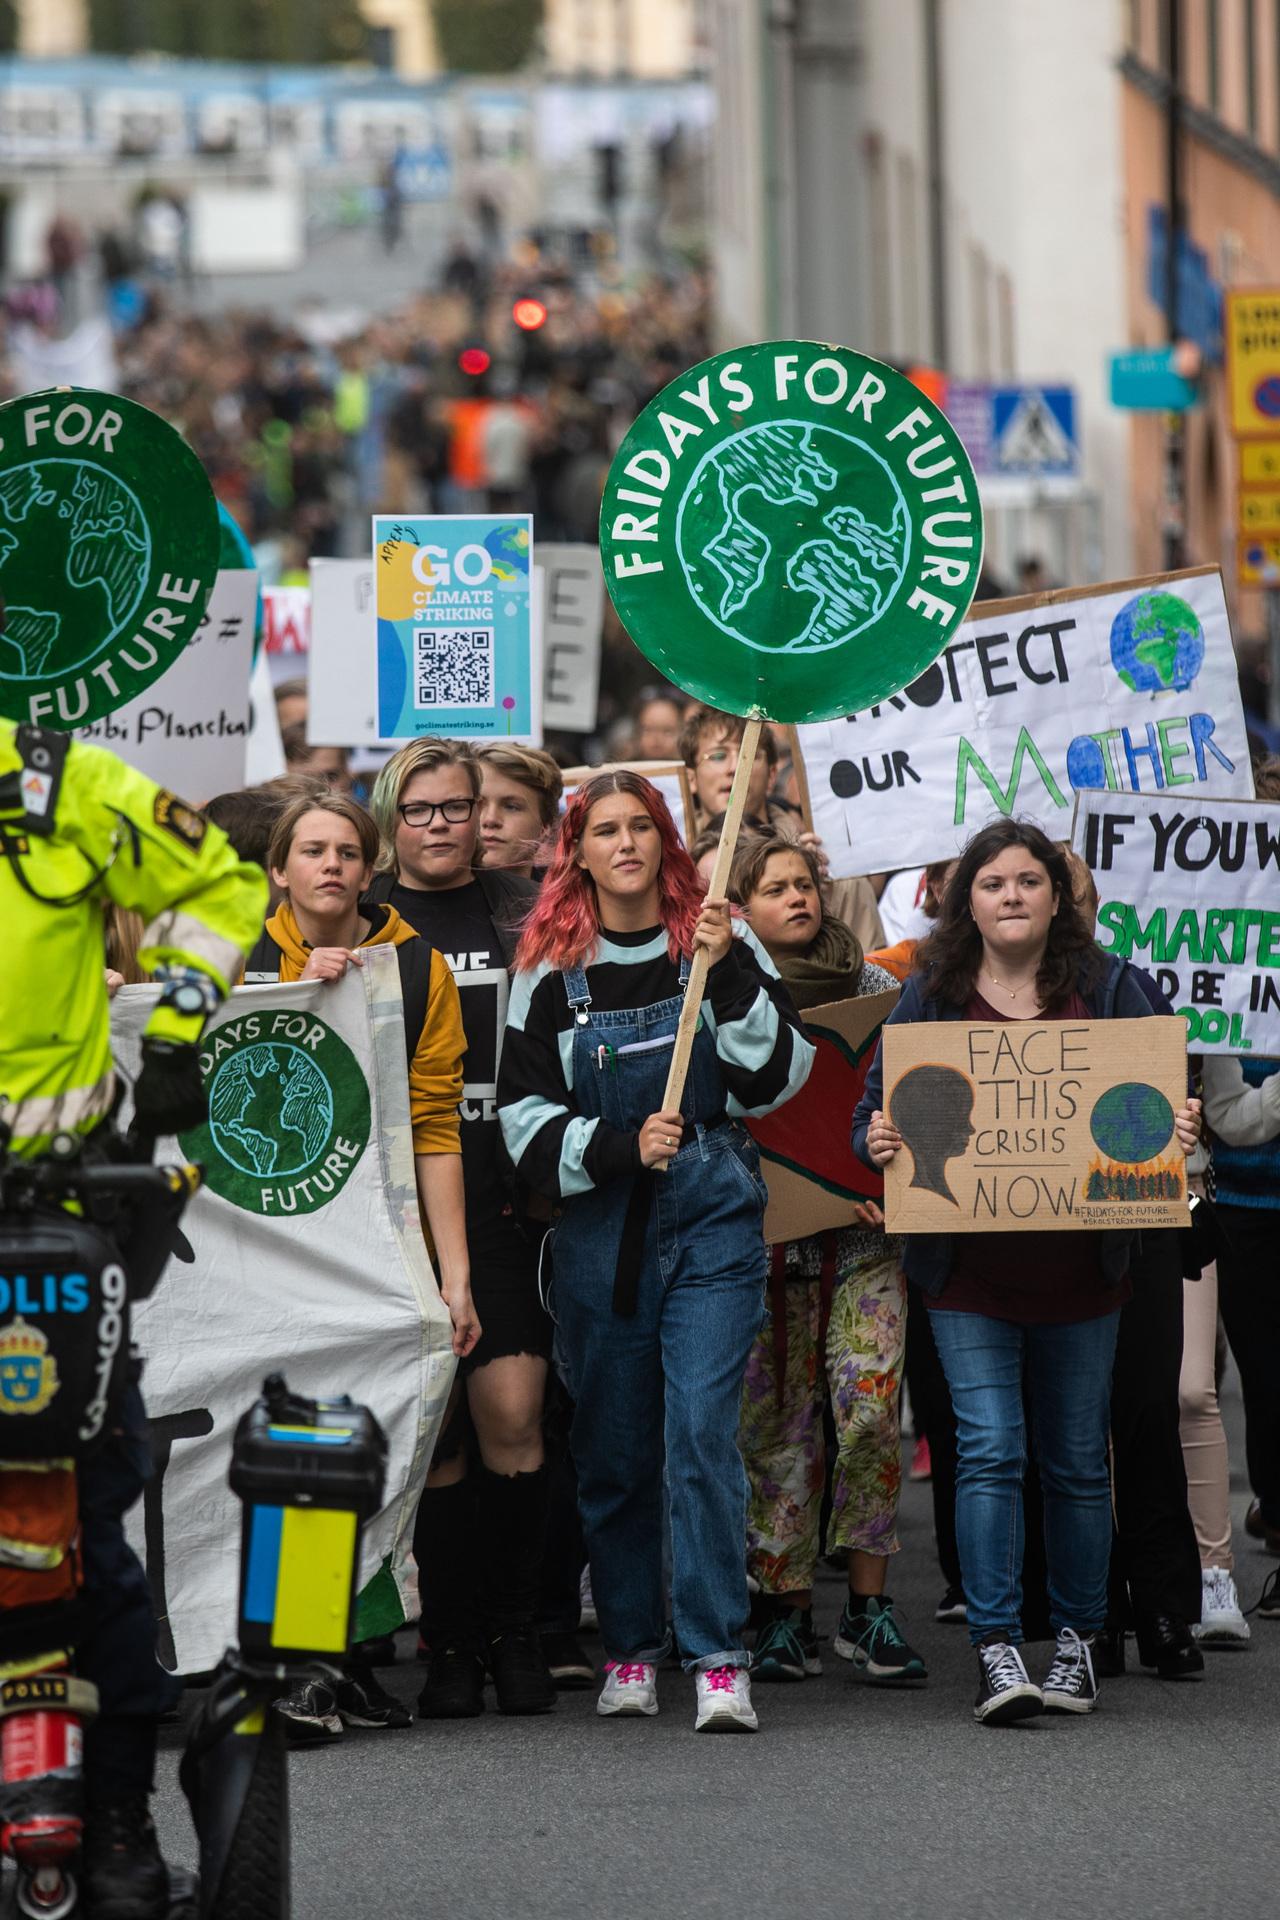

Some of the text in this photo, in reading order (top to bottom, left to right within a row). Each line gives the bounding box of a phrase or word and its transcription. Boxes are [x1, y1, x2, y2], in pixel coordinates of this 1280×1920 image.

[24, 403, 123, 453] FOR
[612, 355, 973, 628] FRIDAYS FOR FUTURE
[411, 543, 493, 586] GO
[413, 590, 494, 606] CLIMATE
[413, 607, 494, 622] STRIKING
[28, 573, 201, 728] FUTURE
[846, 619, 1077, 723] OTECT
[415, 721, 495, 731] goclimatestriking.se
[829, 712, 1236, 825] OUR MOTHER
[1085, 813, 1135, 871] IF
[1149, 812, 1248, 873] YOU
[1191, 969, 1226, 1007] BE
[199, 1013, 326, 1085] DAYS FOR
[968, 1028, 1091, 1075] FACE
[978, 1079, 1082, 1120] THIS
[975, 1127, 1066, 1155] CRISIS
[260, 1136, 360, 1212] FUTURE
[973, 1175, 1077, 1219] NOW
[1074, 1206, 1169, 1218] #FRIDAYS FOR FUTURE
[3, 1682, 65, 1700] POLIS
